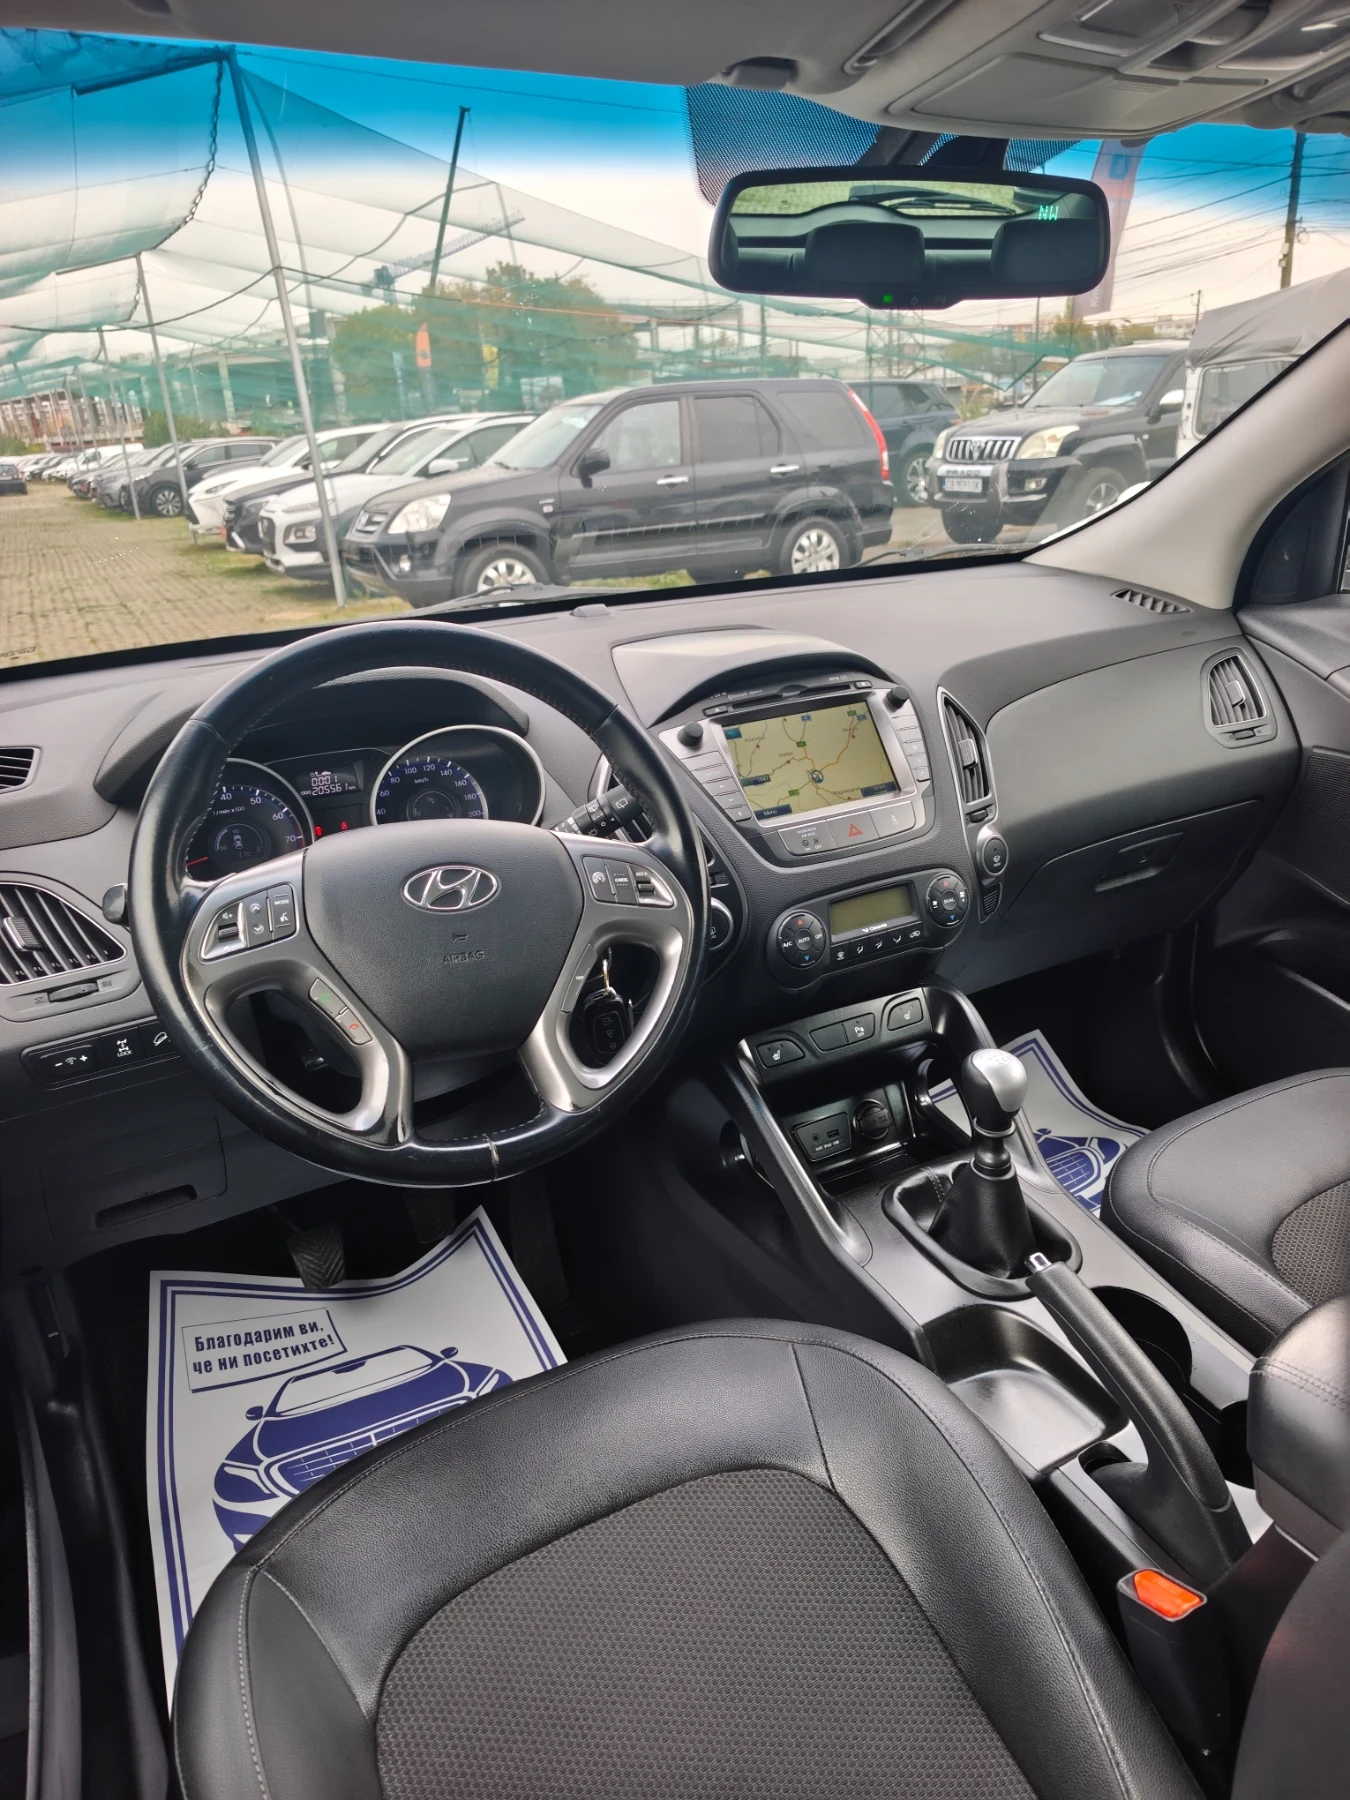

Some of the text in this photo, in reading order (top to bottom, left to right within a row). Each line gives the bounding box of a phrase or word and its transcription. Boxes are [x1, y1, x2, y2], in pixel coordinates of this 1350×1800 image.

[1038, 205, 1058, 220] NW
[454, 780, 467, 788] 160
[220, 792, 232, 800] 40
[250, 796, 262, 805] 50
[464, 793, 476, 801] 180
[272, 812, 284, 820] 60
[468, 810, 481, 818] 200
[285, 835, 296, 844] 70
[443, 950, 485, 964] AIRBAG
[194, 1322, 324, 1352] Благодарим ви,
[192, 1334, 335, 1374] че ни посетихте!
